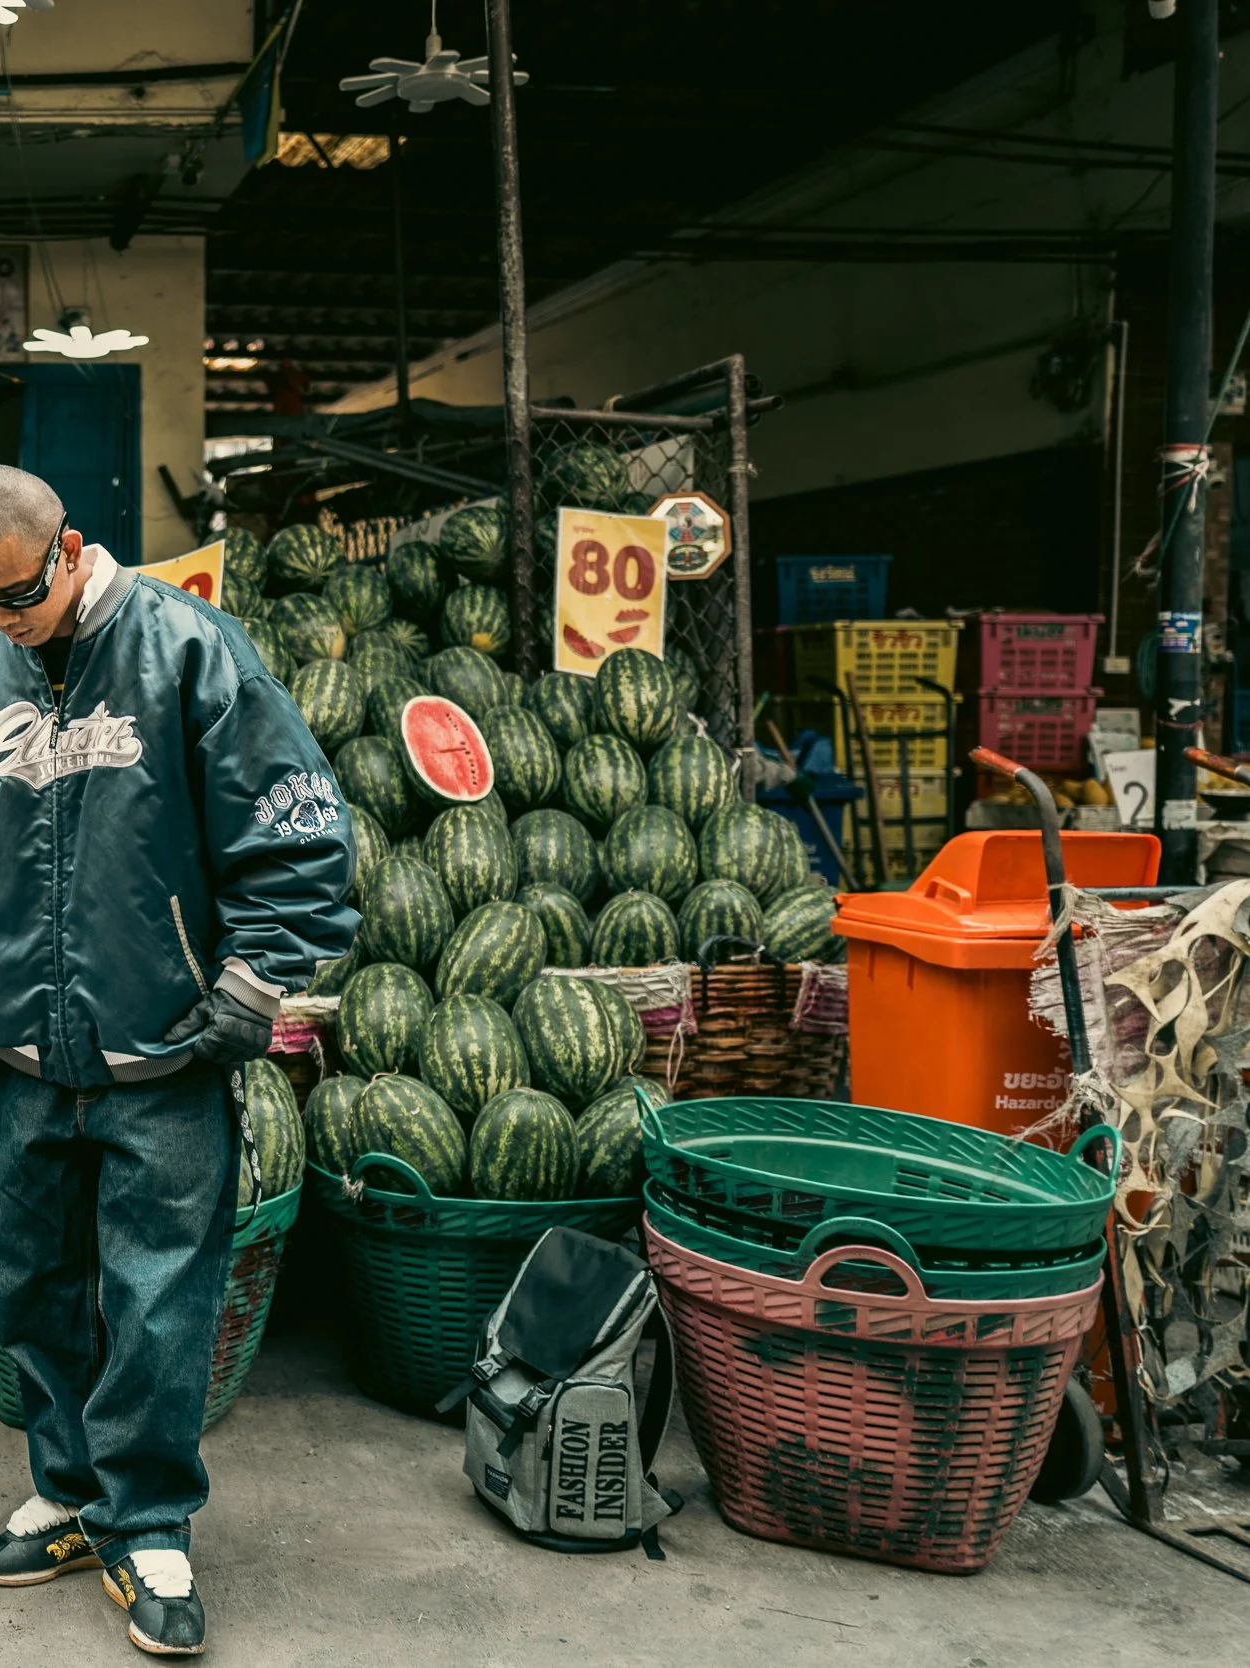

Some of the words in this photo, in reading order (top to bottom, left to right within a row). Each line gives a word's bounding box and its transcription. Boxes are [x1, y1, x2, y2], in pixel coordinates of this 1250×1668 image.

[568, 540, 656, 602] 80
[255, 771, 339, 825] JOKER
[274, 820, 293, 838] 19
[322, 805, 339, 822] 69
[556, 1417, 591, 1522] FASHION
[593, 1420, 628, 1522] INSIDER
